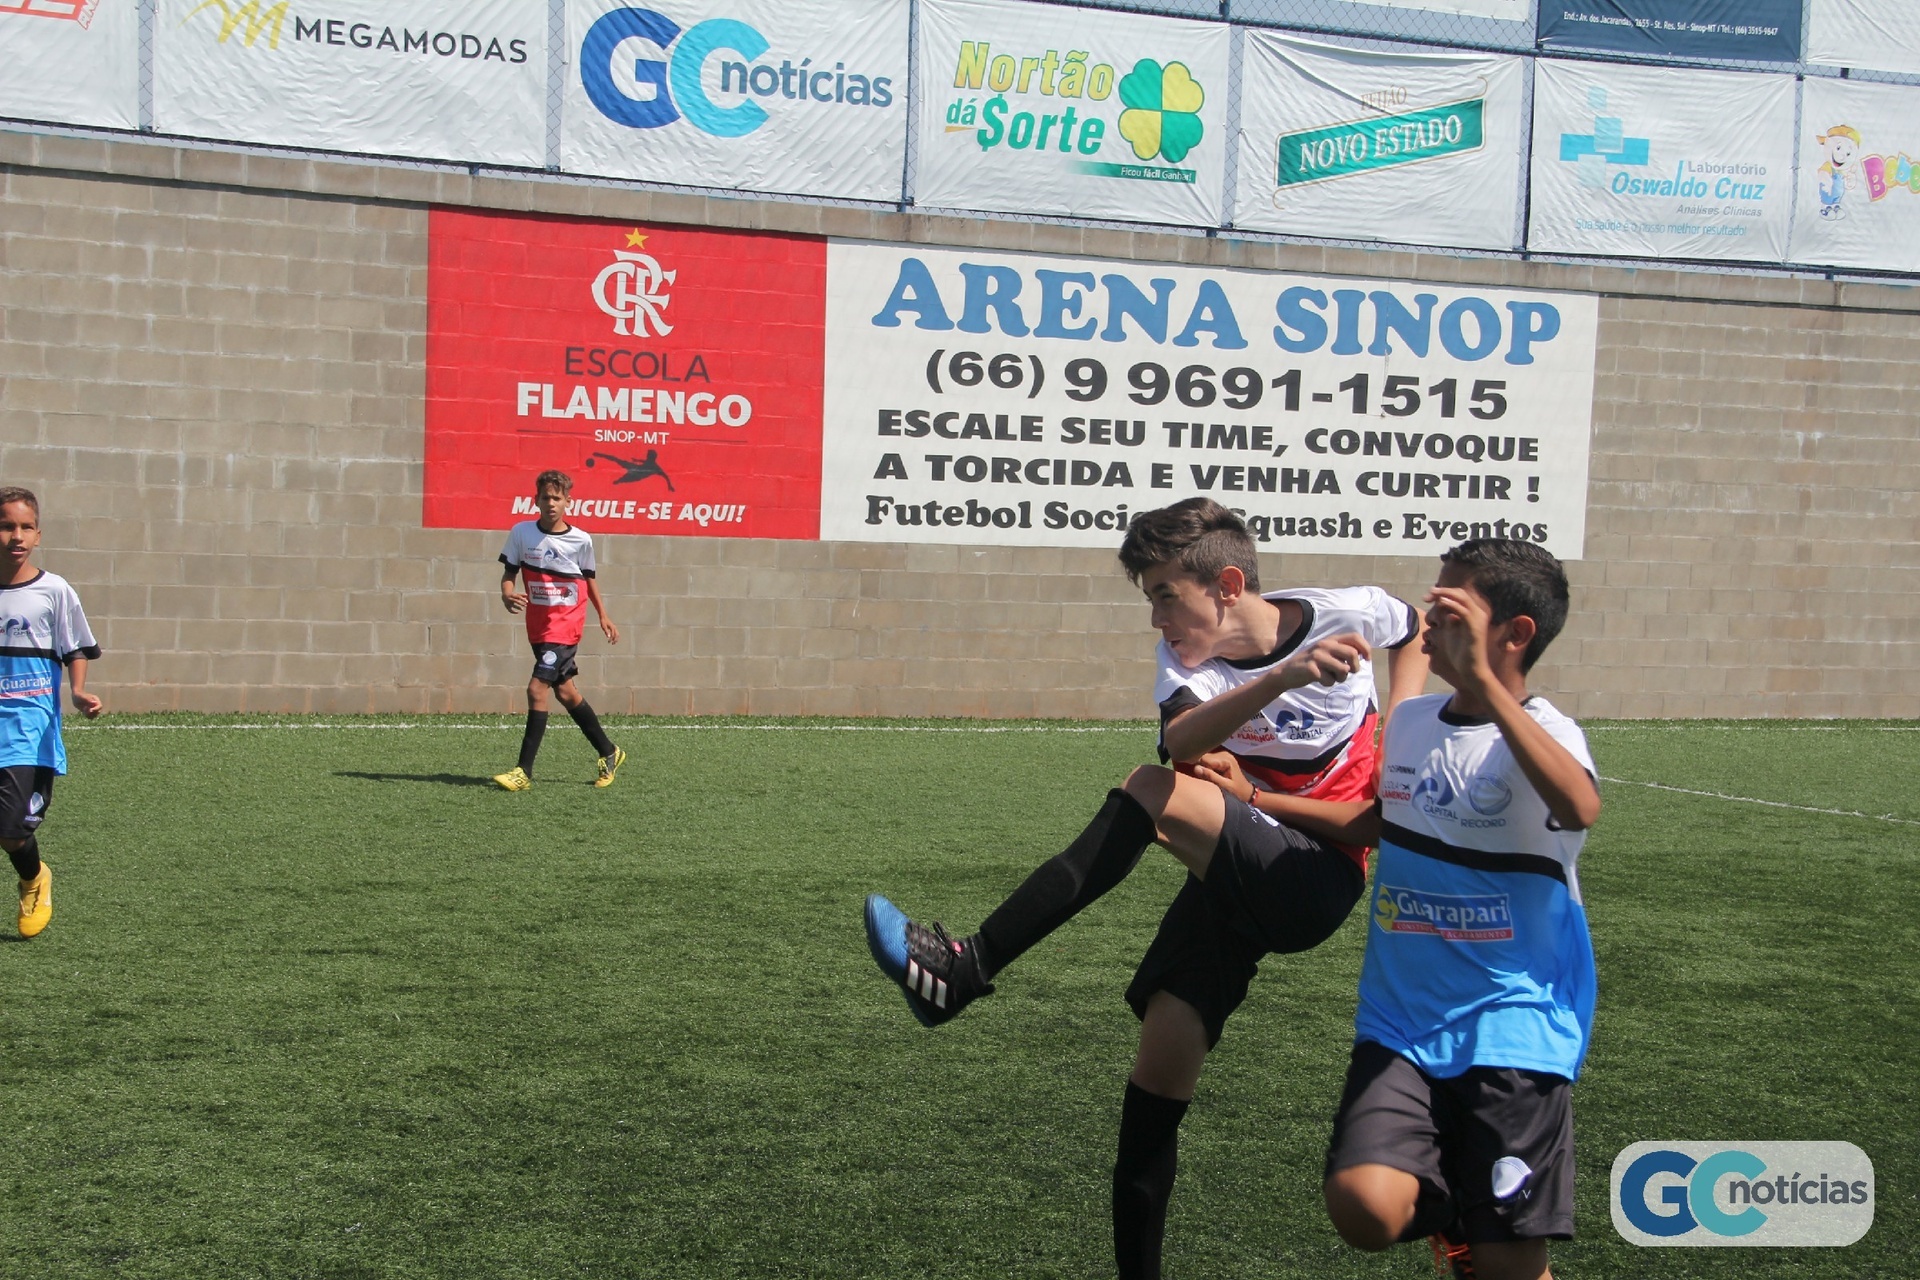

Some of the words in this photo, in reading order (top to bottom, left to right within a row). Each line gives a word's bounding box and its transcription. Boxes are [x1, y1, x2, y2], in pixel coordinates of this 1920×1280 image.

[296, 15, 528, 64] MEGAMODAS
[1589, 14, 1600, 23] dos
[1663, 21, 1676, 30] Res.
[1735, 25, 1747, 36] (66)
[721, 58, 893, 108] notícias
[953, 40, 1115, 101] Nortão
[946, 97, 977, 126] dá
[1299, 133, 1367, 173] NOVO
[1373, 114, 1464, 158] ESTADO
[1121, 167, 1142, 177] Ficou
[1143, 168, 1161, 178] fácil
[1611, 160, 1708, 199] Oswaldo
[1714, 177, 1766, 200] Cruz
[1688, 161, 1767, 176] Laboratório
[1576, 218, 1593, 231] Sua
[1594, 218, 1621, 231] saúde
[1667, 223, 1701, 235] melhor
[1676, 204, 1720, 216] Análises
[1722, 205, 1763, 217] Clínicas
[871, 257, 1248, 349] ARENA
[1273, 286, 1561, 366] SINOP
[564, 346, 711, 384] ESCOLA
[926, 349, 1045, 400] (66)
[1064, 358, 1108, 402] 9
[1127, 361, 1508, 421] 9691-1515
[516, 381, 752, 428] FLAMENGO
[594, 428, 671, 447] SINOP-MT
[878, 409, 1044, 442] ESCALE
[1060, 417, 1146, 447] SEU
[1162, 421, 1289, 458] TIME,
[1304, 428, 1539, 464] CONVOQUE
[873, 453, 909, 480] A
[925, 454, 1134, 488] TORCIDA
[1150, 463, 1173, 489] E
[1190, 464, 1342, 495] VENHA
[1355, 471, 1512, 501] CURTIR
[1526, 476, 1541, 503] !
[511, 495, 674, 522] MARICULE-SE
[677, 502, 747, 527] AQUI!
[864, 494, 1033, 530] Futebol
[1372, 519, 1392, 539] e
[1402, 512, 1548, 544] Eventos
[1288, 725, 1300, 734] TV
[1289, 728, 1323, 741] CAPITAL
[1423, 803, 1459, 820] CAPITAL
[1460, 818, 1507, 829] RECORD
[1396, 892, 1509, 931] Guarapari
